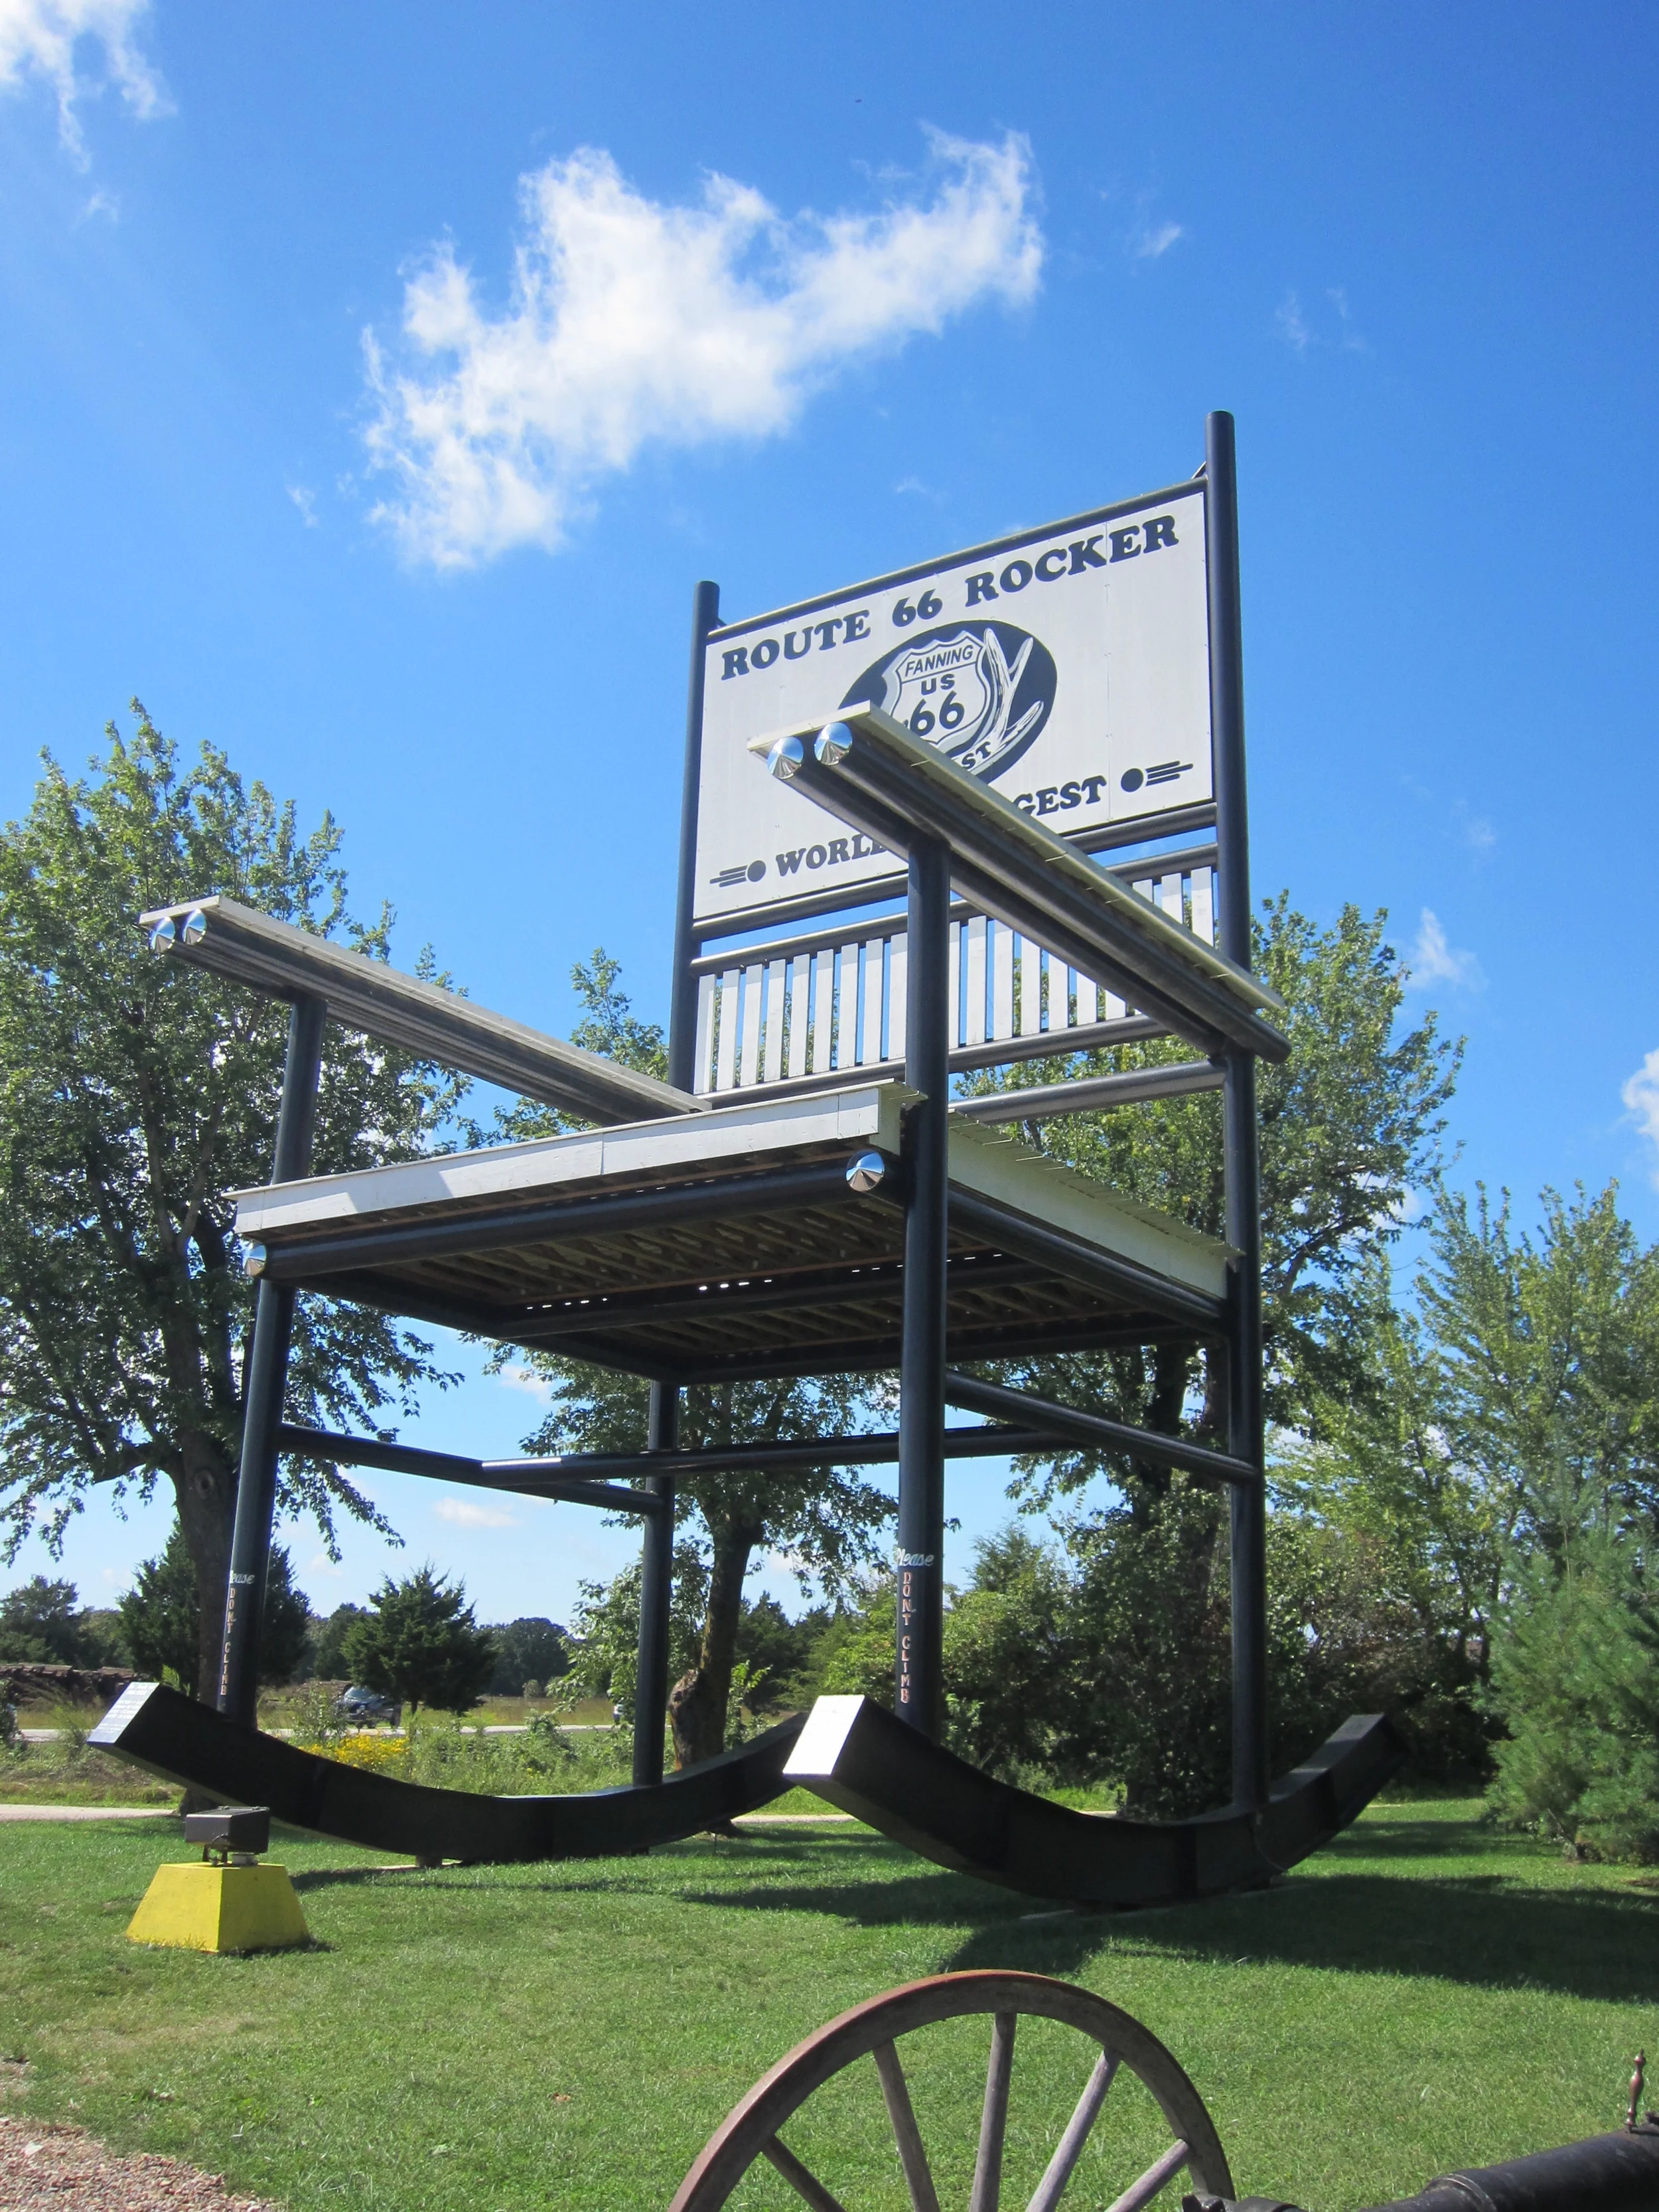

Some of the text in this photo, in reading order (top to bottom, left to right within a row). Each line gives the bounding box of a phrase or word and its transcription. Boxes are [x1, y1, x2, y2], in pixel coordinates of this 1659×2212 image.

[721, 515, 1179, 681] ROUTE 66 ROCKER
[904, 644, 974, 677] FANNING
[921, 673, 955, 696] US
[910, 690, 965, 737] 66
[1013, 775, 1107, 816] GEST
[901, 1635, 911, 1704] CLIMB
